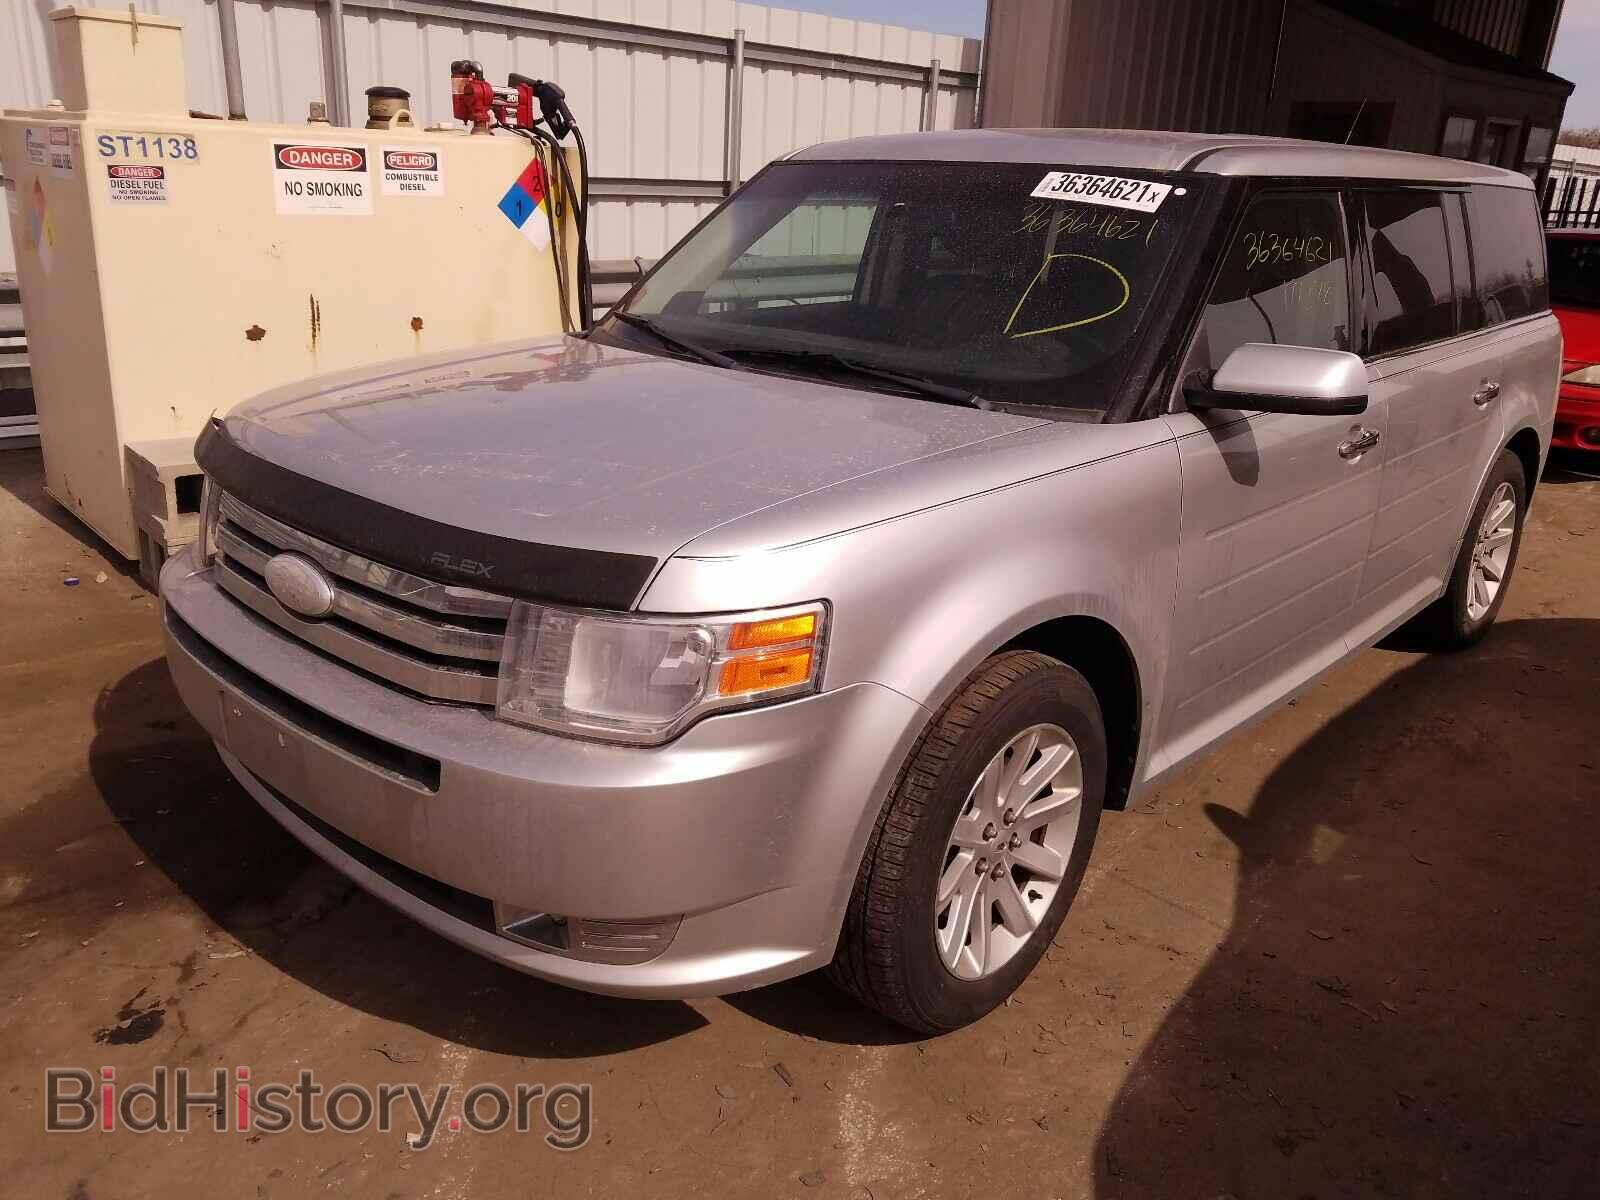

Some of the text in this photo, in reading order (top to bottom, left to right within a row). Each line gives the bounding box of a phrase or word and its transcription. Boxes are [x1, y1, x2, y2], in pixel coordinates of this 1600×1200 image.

[97, 135, 198, 160] ST1138
[288, 151, 353, 166] DANGER
[390, 154, 432, 166] PELIGRO
[118, 167, 155, 177] DANGER
[385, 173, 439, 181] COMBUSTIBLE
[110, 180, 165, 189] DIESEL FUEL
[285, 181, 363, 197] NO SMOKING
[400, 183, 426, 191] DIESEL
[532, 176, 541, 192] 2
[1051, 174, 1152, 203] 36364621
[516, 200, 522, 216] 1
[431, 552, 496, 578] FLEX
